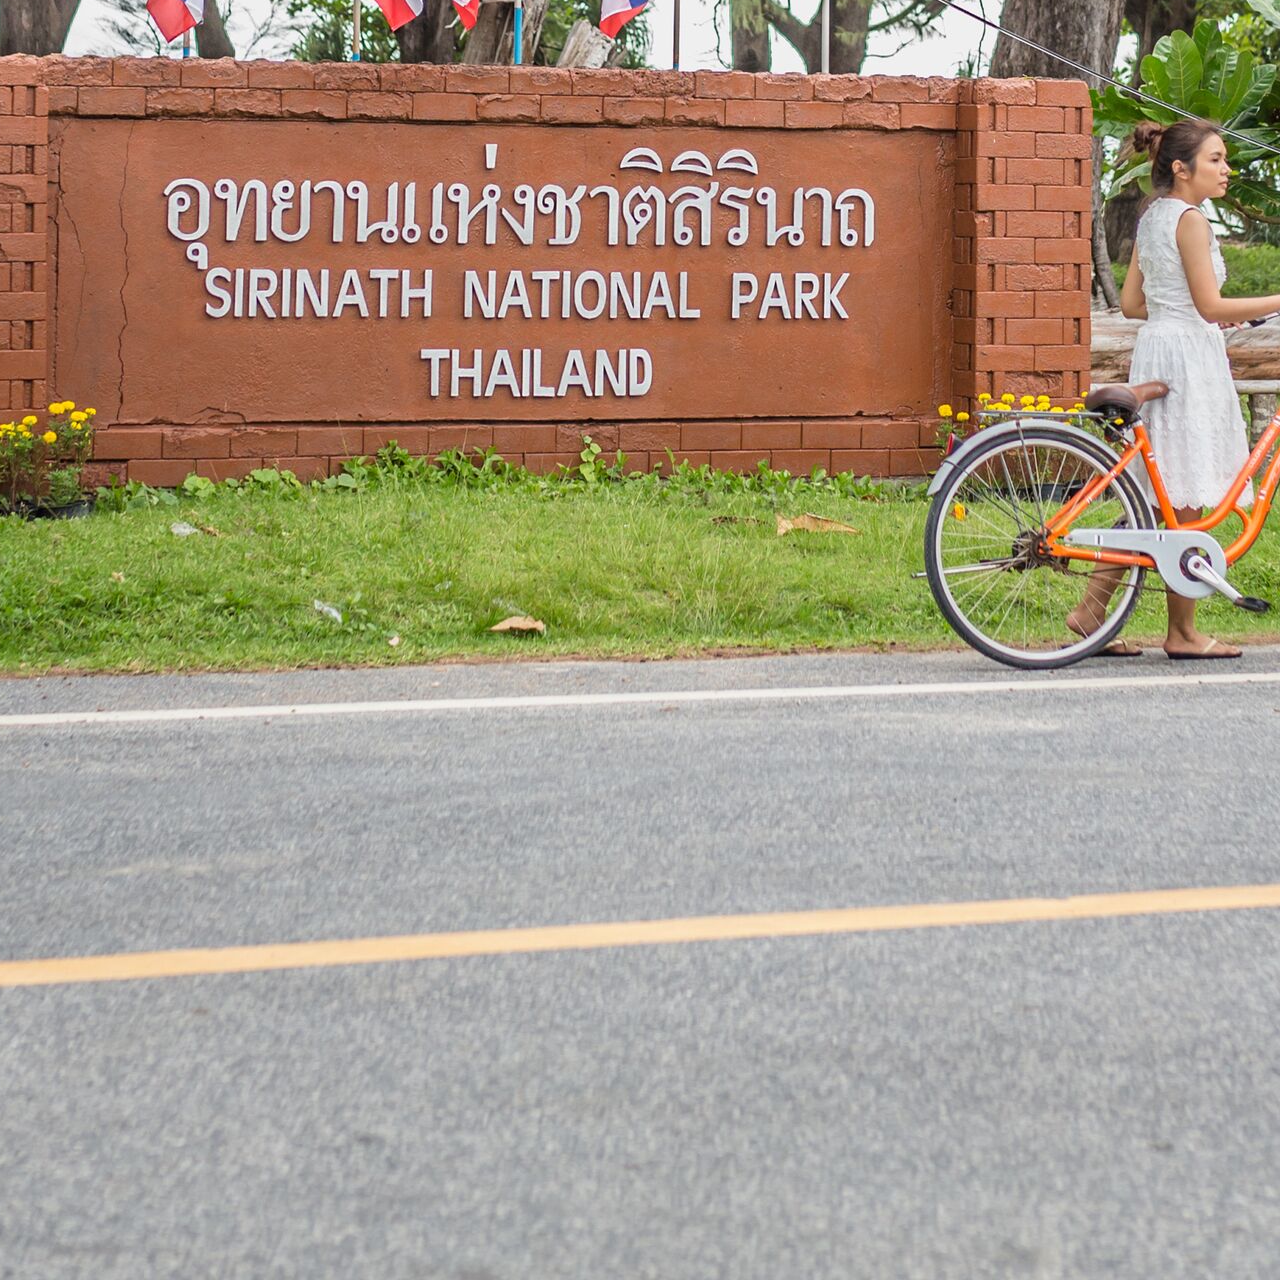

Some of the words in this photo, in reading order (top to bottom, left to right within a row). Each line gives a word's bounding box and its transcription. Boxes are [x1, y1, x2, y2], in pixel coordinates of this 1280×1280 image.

[163, 143, 876, 269] อุทยานแห่งชาติสิรินาถ
[205, 267, 433, 319] SIRINATH
[463, 269, 701, 320] NATIONAL
[731, 271, 851, 320] PARK
[420, 348, 653, 398] THAILAND
